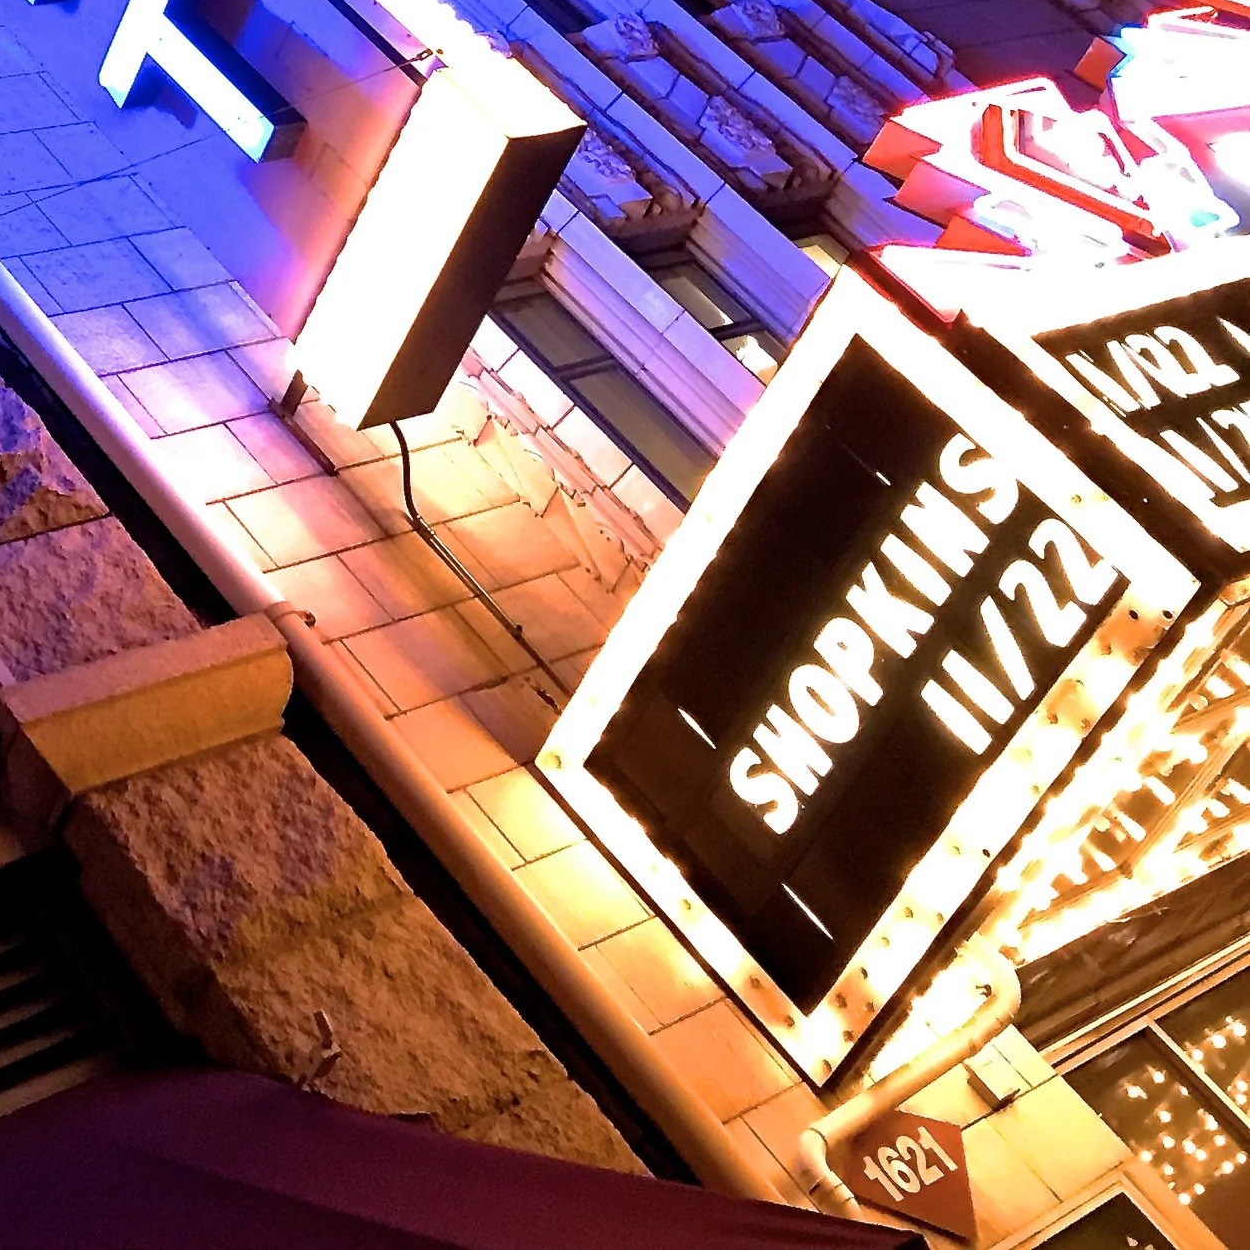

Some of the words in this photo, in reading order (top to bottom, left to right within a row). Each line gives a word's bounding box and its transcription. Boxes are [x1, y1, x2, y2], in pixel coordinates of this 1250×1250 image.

[729, 433, 1020, 835] SHOPKINS
[919, 518, 1120, 756] 11/22
[863, 1126, 959, 1202] 1621
